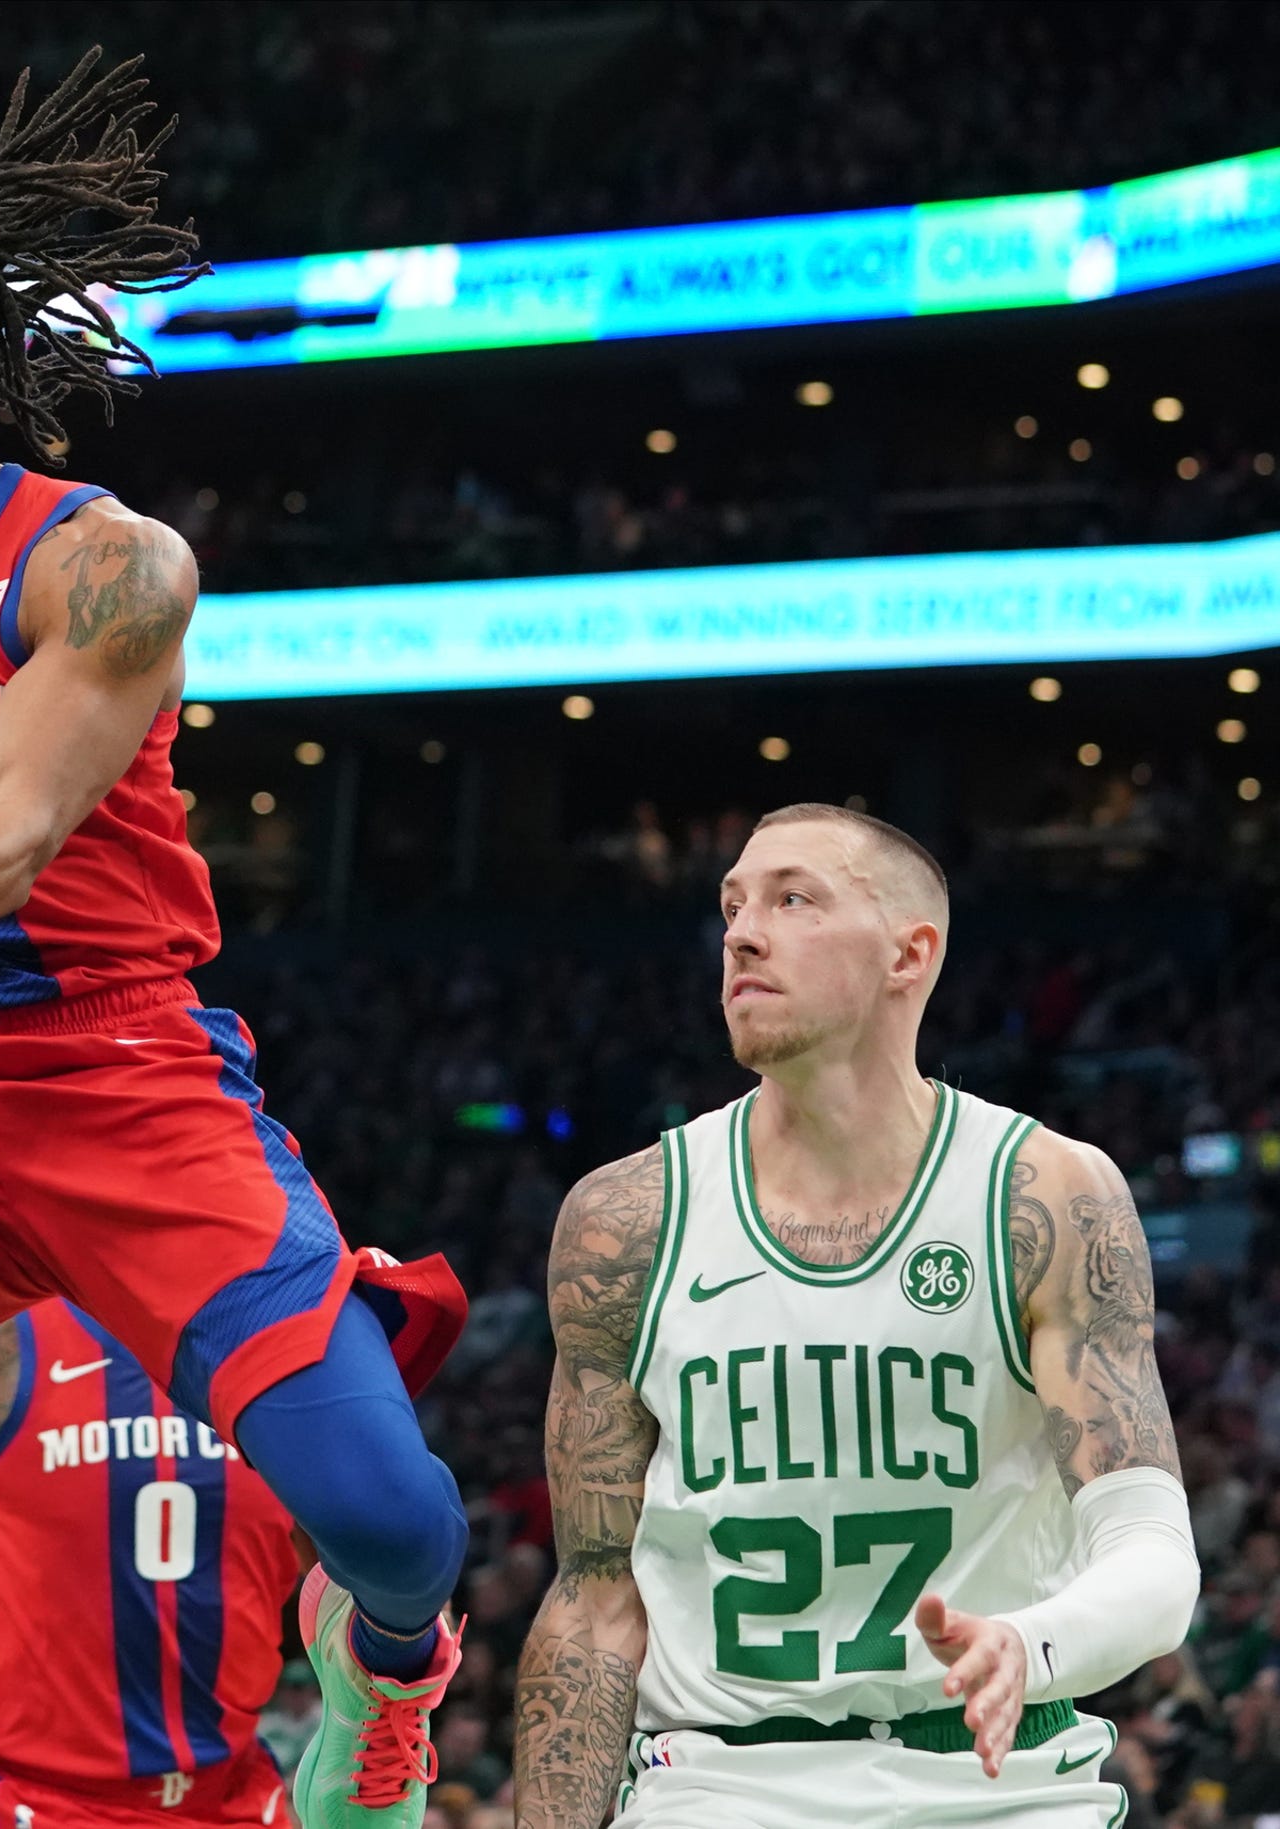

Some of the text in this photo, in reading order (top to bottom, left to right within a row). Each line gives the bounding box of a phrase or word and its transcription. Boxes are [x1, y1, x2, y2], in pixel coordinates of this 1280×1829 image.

[916, 1255, 961, 1300] GE
[37, 1415, 240, 1473] MOTOR C
[679, 1344, 980, 1494] CELTICS
[134, 1481, 197, 1581] 0
[709, 1507, 952, 1682] 27
